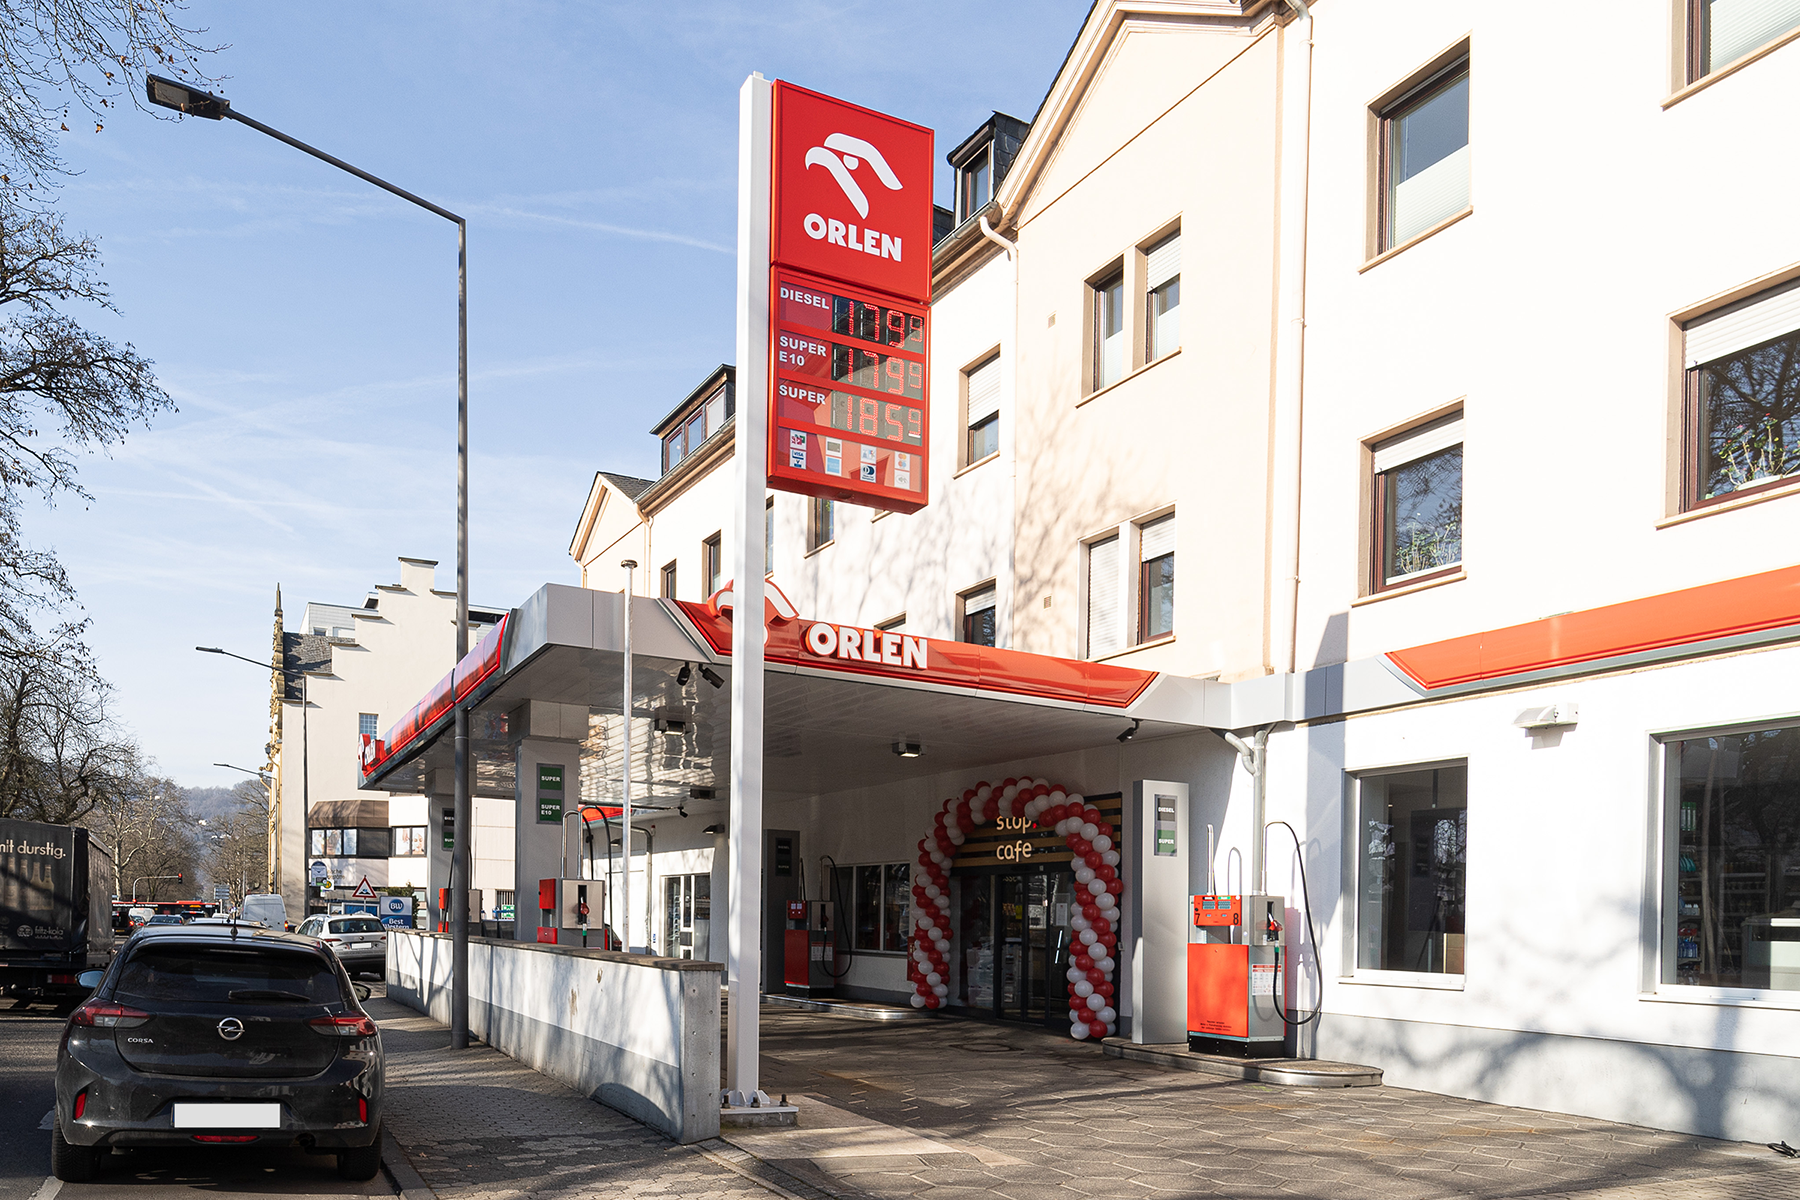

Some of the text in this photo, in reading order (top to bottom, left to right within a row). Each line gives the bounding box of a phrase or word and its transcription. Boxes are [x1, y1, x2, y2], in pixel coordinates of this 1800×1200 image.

[803, 212, 902, 263] ORLEN
[780, 287, 830, 310] DIESEL
[779, 336, 827, 357] SUPER
[779, 350, 805, 367] E10
[778, 384, 826, 405] SUPER
[808, 622, 928, 669] ORLEN
[17, 840, 66, 860] durstig.
[996, 840, 1032, 863] cafe
[390, 902, 403, 910] BW
[1195, 912, 1239, 925] 7 8
